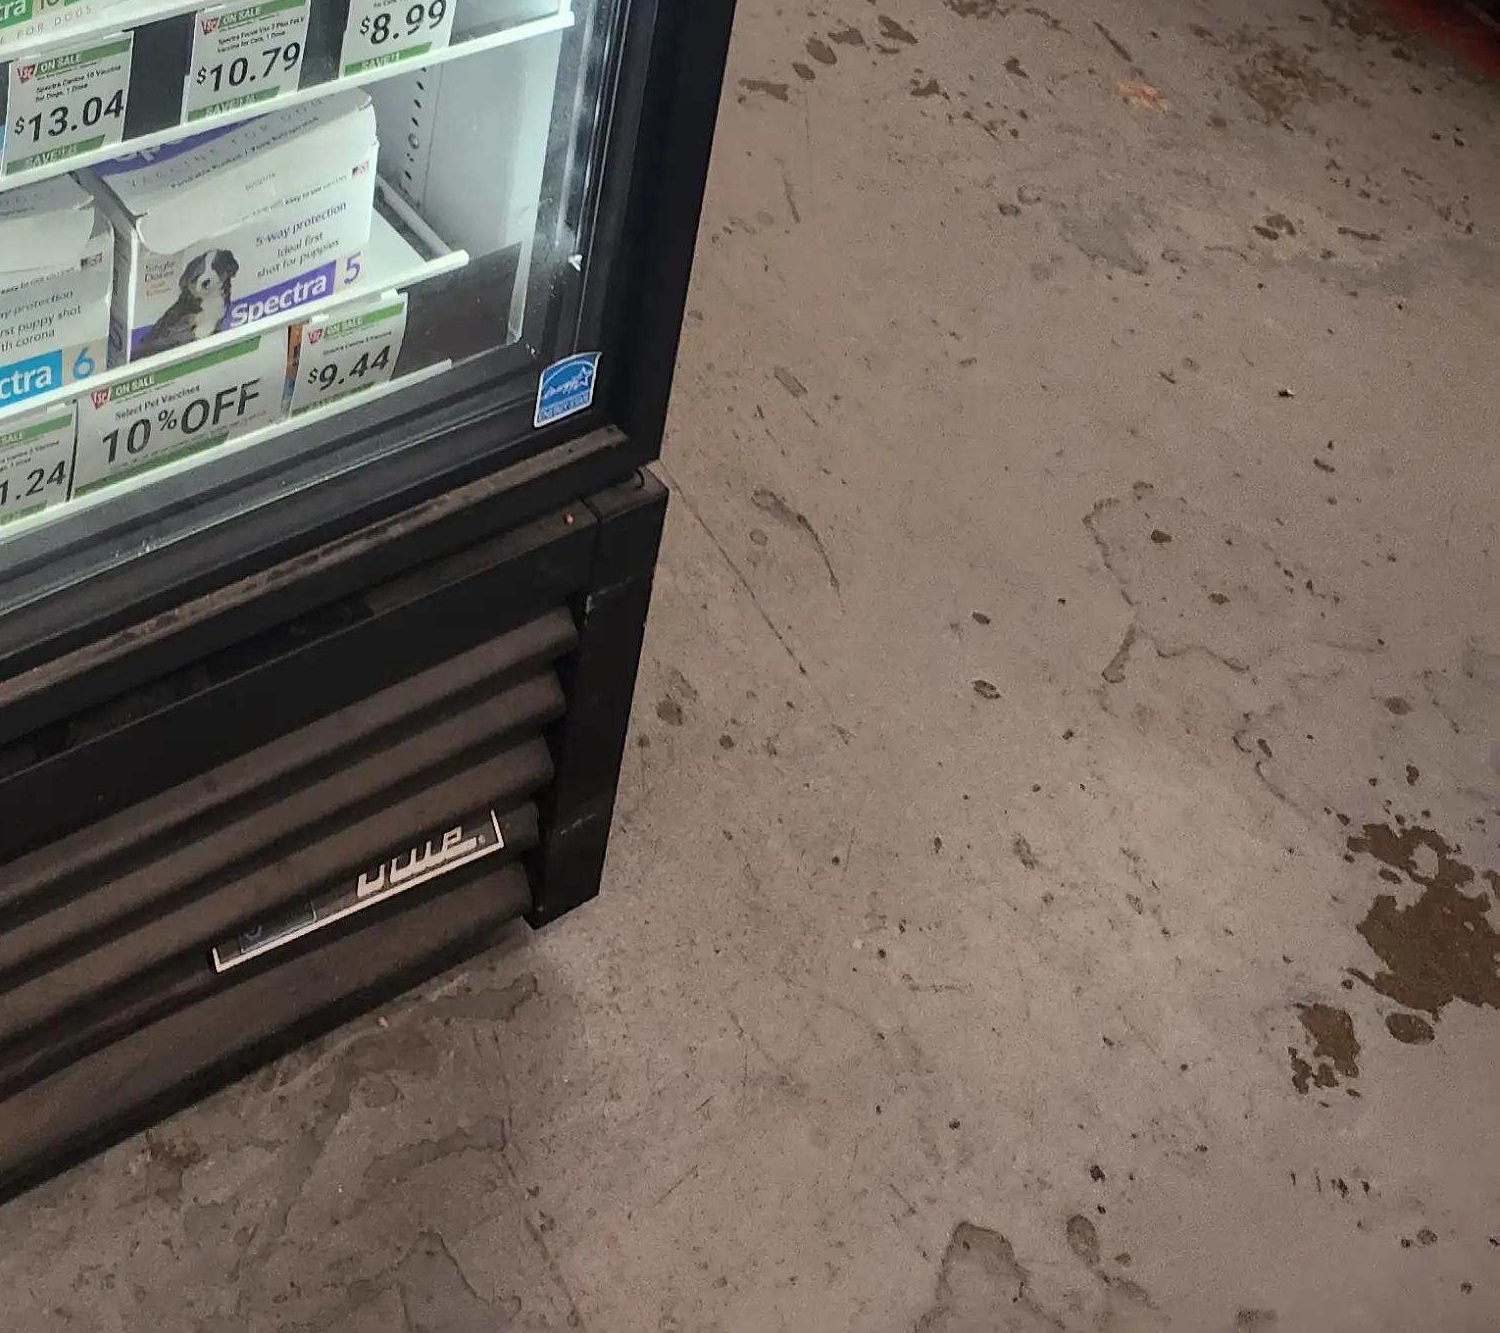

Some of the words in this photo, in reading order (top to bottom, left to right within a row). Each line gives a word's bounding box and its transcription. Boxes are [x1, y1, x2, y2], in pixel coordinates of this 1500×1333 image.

[196, 41, 301, 92] $10.79
[14, 89, 125, 142] $13.04
[255, 227, 291, 248] 5-way
[292, 202, 347, 234] protection
[18, 316, 55, 339] puppy
[57, 306, 82, 323] shot
[229, 274, 327, 328] Spectra
[16, 329, 55, 350] corona
[72, 347, 95, 380] 6
[307, 345, 391, 392] $9.44
[102, 409, 177, 465] 10%
[180, 378, 260, 435] OFF
[115, 407, 143, 421] Select
[144, 400, 159, 413] Pet
[161, 385, 200, 406] Vaccines
